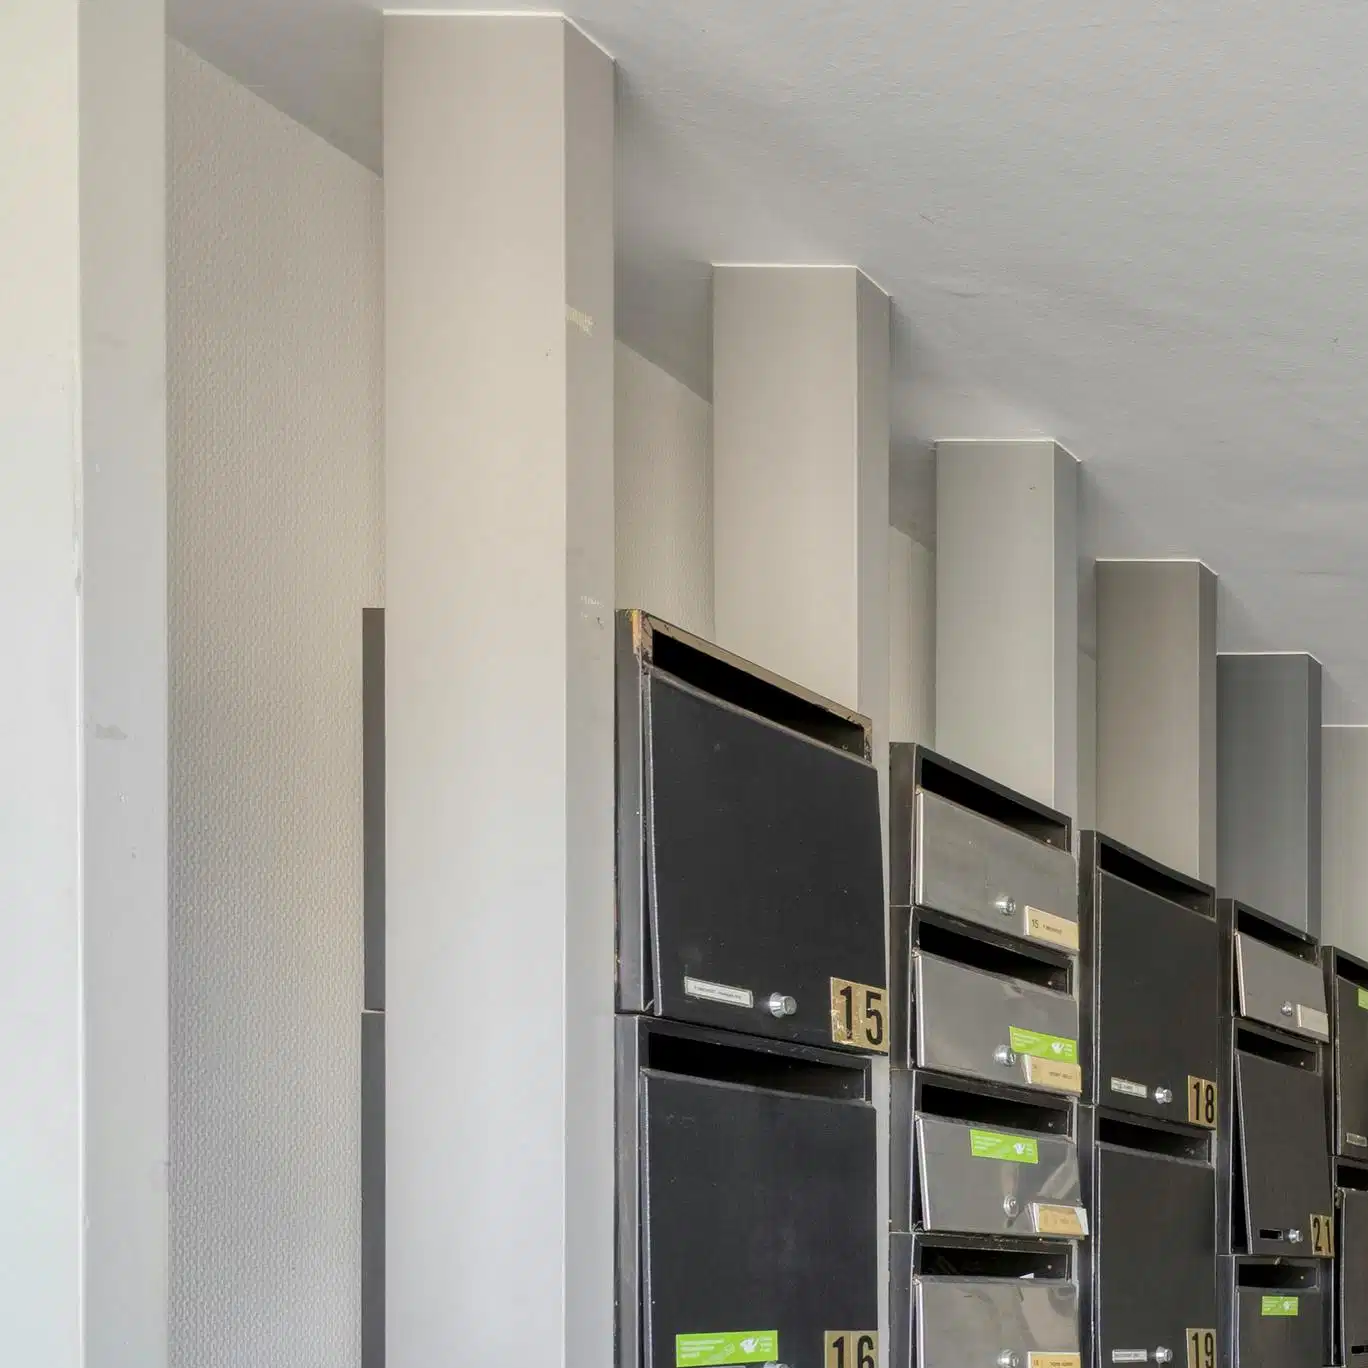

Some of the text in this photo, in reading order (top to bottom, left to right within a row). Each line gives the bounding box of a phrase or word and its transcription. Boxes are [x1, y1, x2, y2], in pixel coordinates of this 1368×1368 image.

[840, 986, 883, 1046] 15
[1193, 1082, 1215, 1123] 18
[1313, 1217, 1331, 1253] 21
